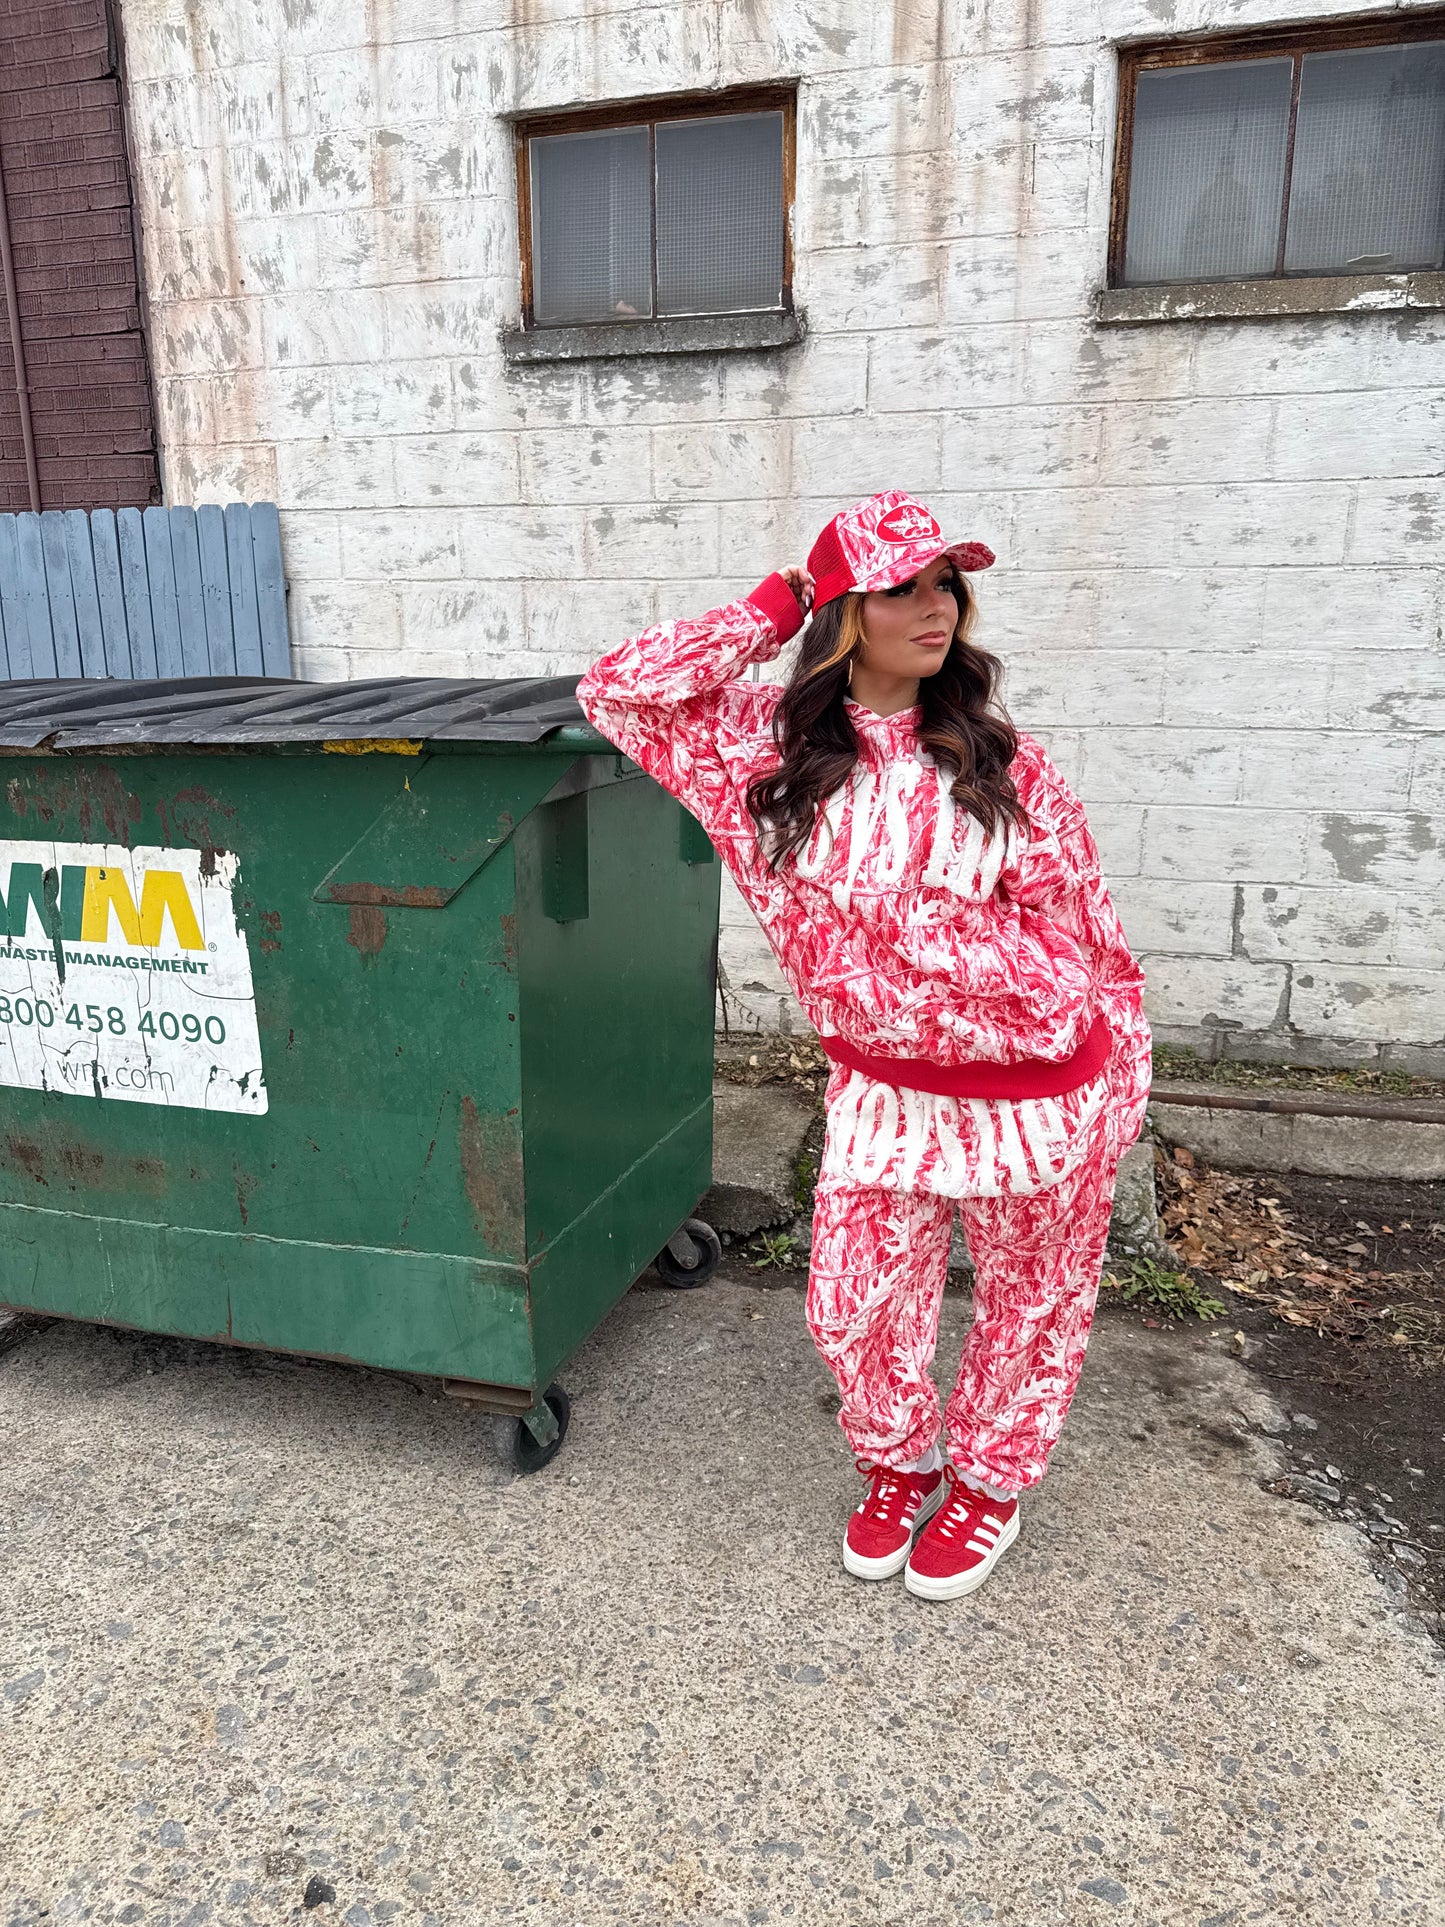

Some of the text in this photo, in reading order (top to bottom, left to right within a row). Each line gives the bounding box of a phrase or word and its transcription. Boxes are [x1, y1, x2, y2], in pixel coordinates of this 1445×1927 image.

[65, 951, 209, 975] MANAGEMENT
[0, 996, 226, 1045] 800 458 4090
[57, 1060, 175, 1092] wm.com
